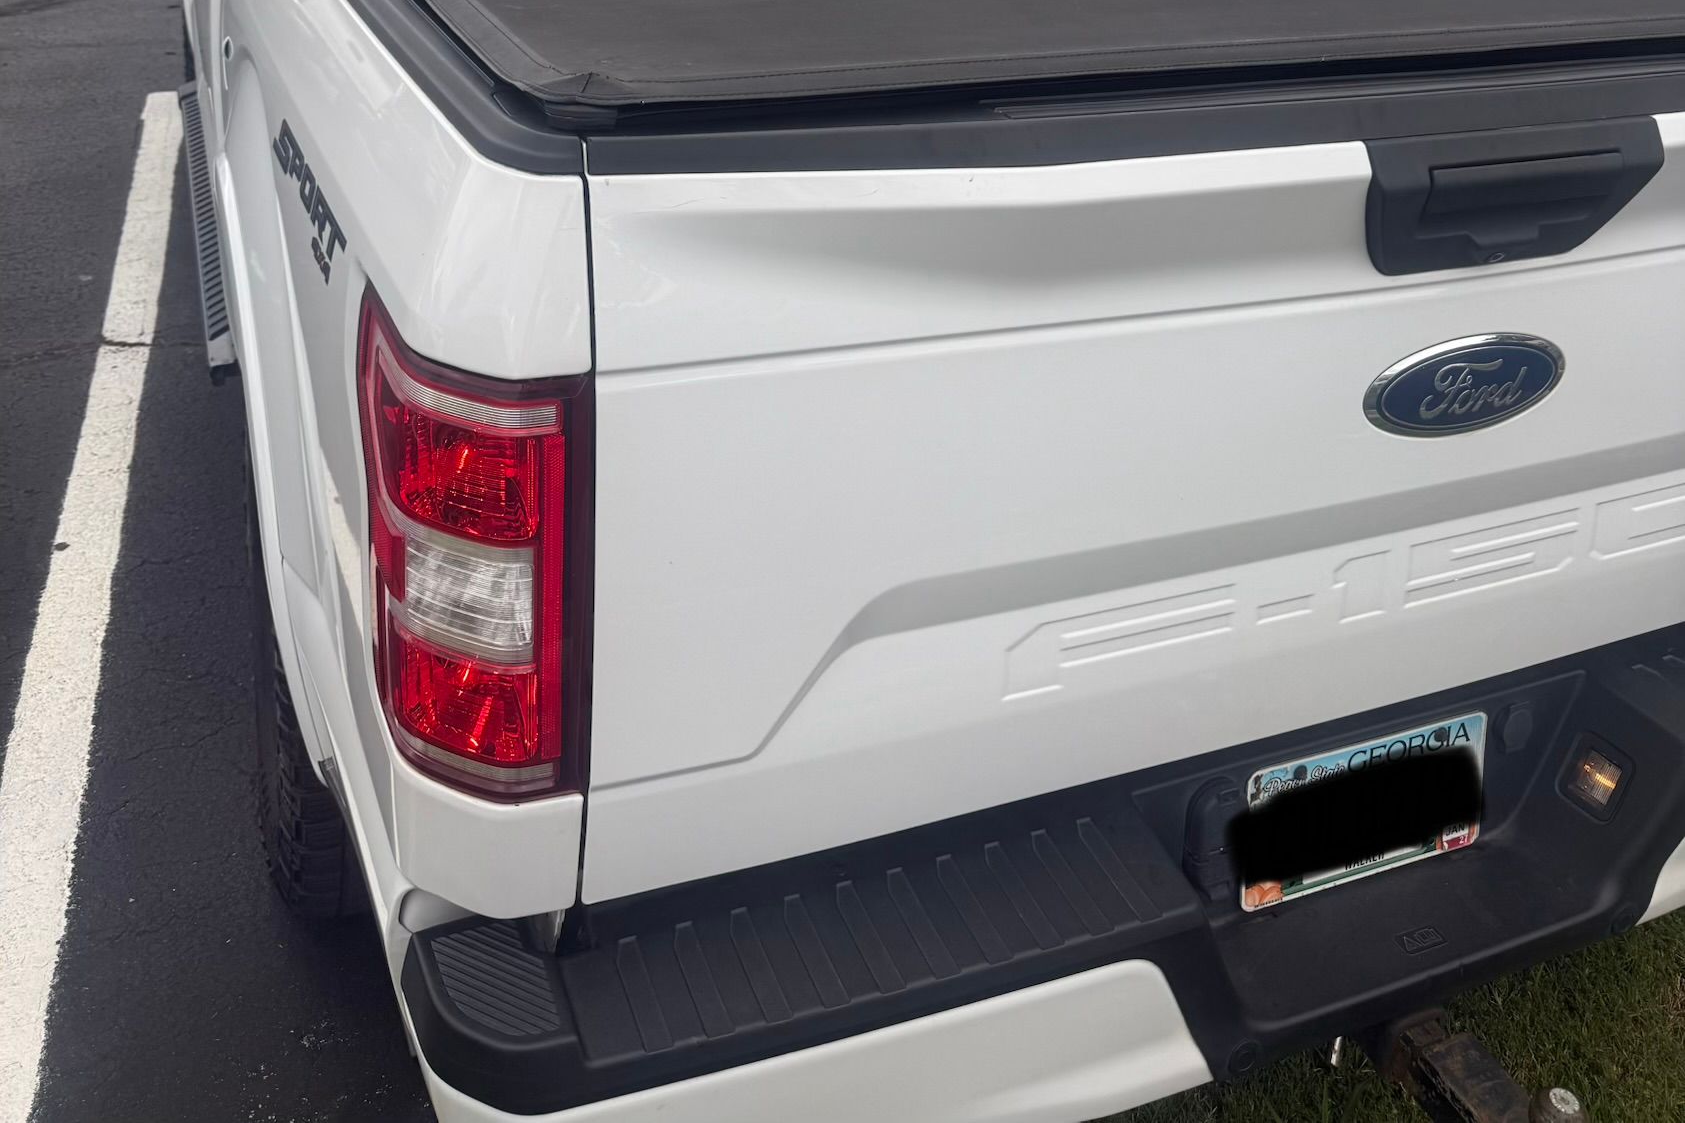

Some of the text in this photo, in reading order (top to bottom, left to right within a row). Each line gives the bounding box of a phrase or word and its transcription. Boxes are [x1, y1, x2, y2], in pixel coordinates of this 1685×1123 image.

[273, 118, 348, 263] SPORT
[1418, 358, 1528, 420] Ford
[1347, 722, 1471, 773] GEORGIA
